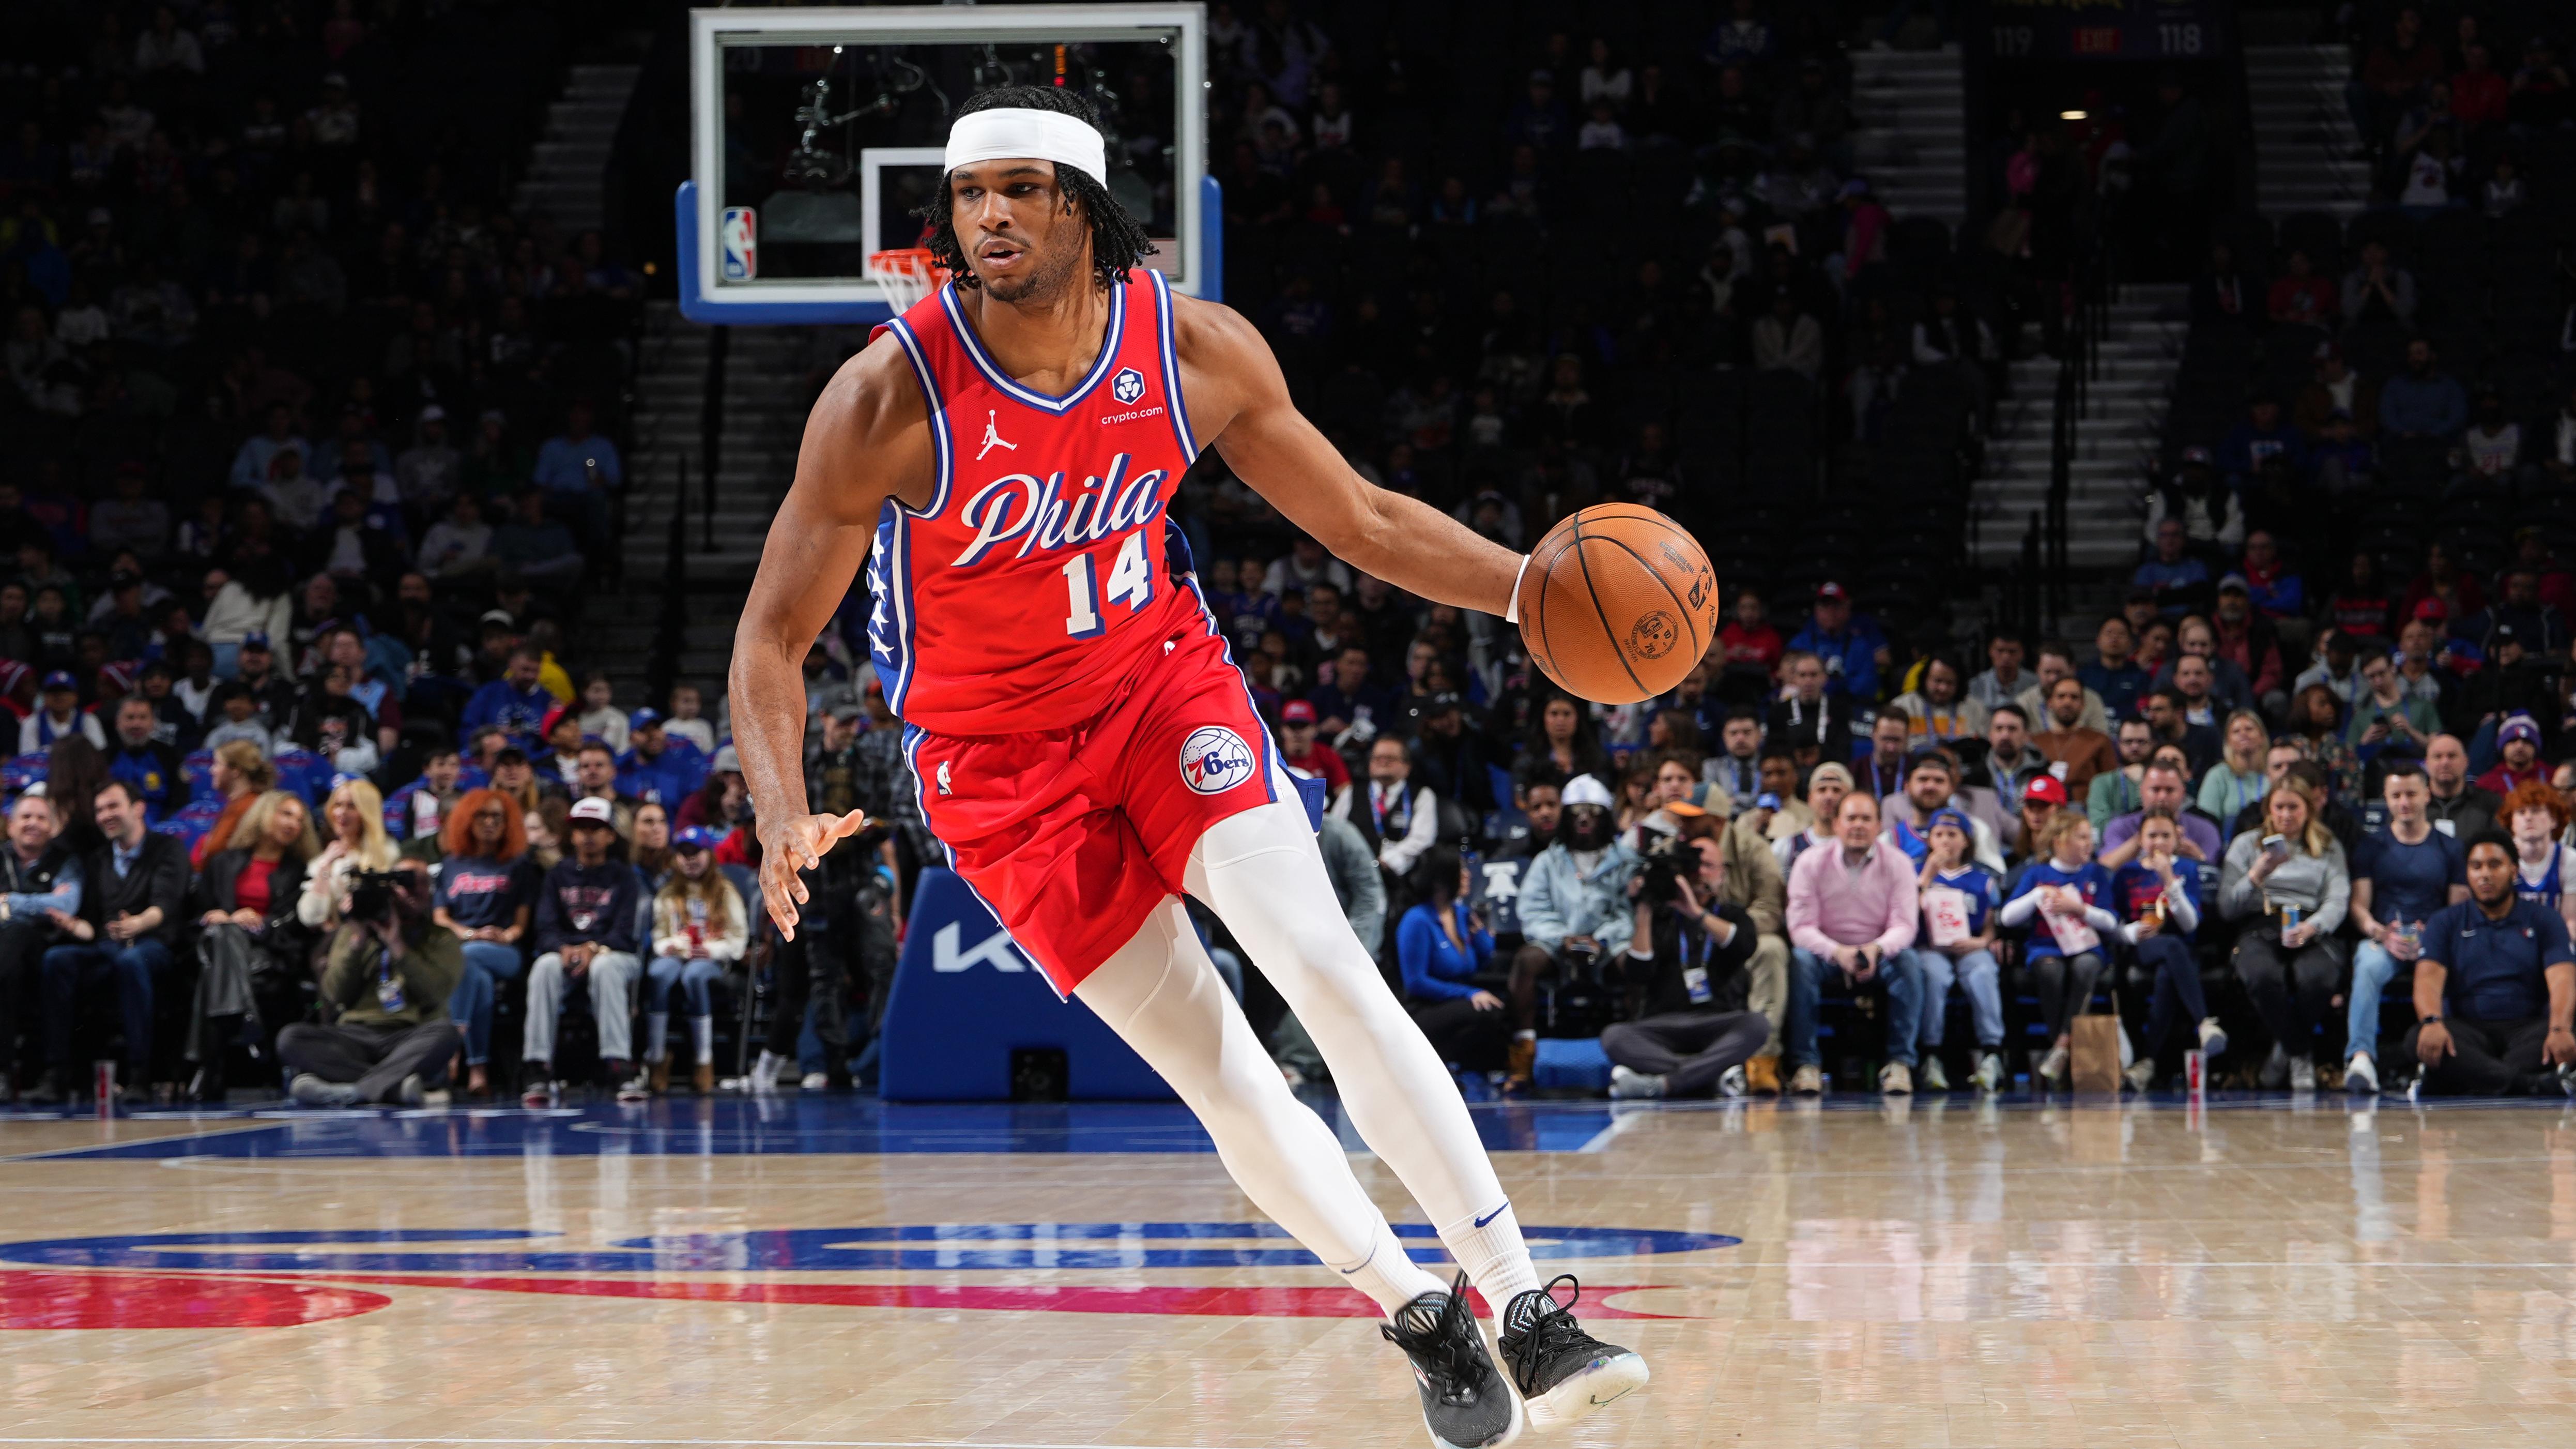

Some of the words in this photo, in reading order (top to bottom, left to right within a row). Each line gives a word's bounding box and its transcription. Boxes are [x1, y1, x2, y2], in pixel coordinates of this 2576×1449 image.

[1992, 25, 2034, 57] 119
[2080, 27, 2115, 51] EXIT
[2158, 23, 2202, 55] 118
[1101, 406, 1163, 424] crypto.com
[950, 452, 1169, 568] Phila
[1063, 527, 1156, 640] 14
[1187, 751, 1250, 786] 76ers
